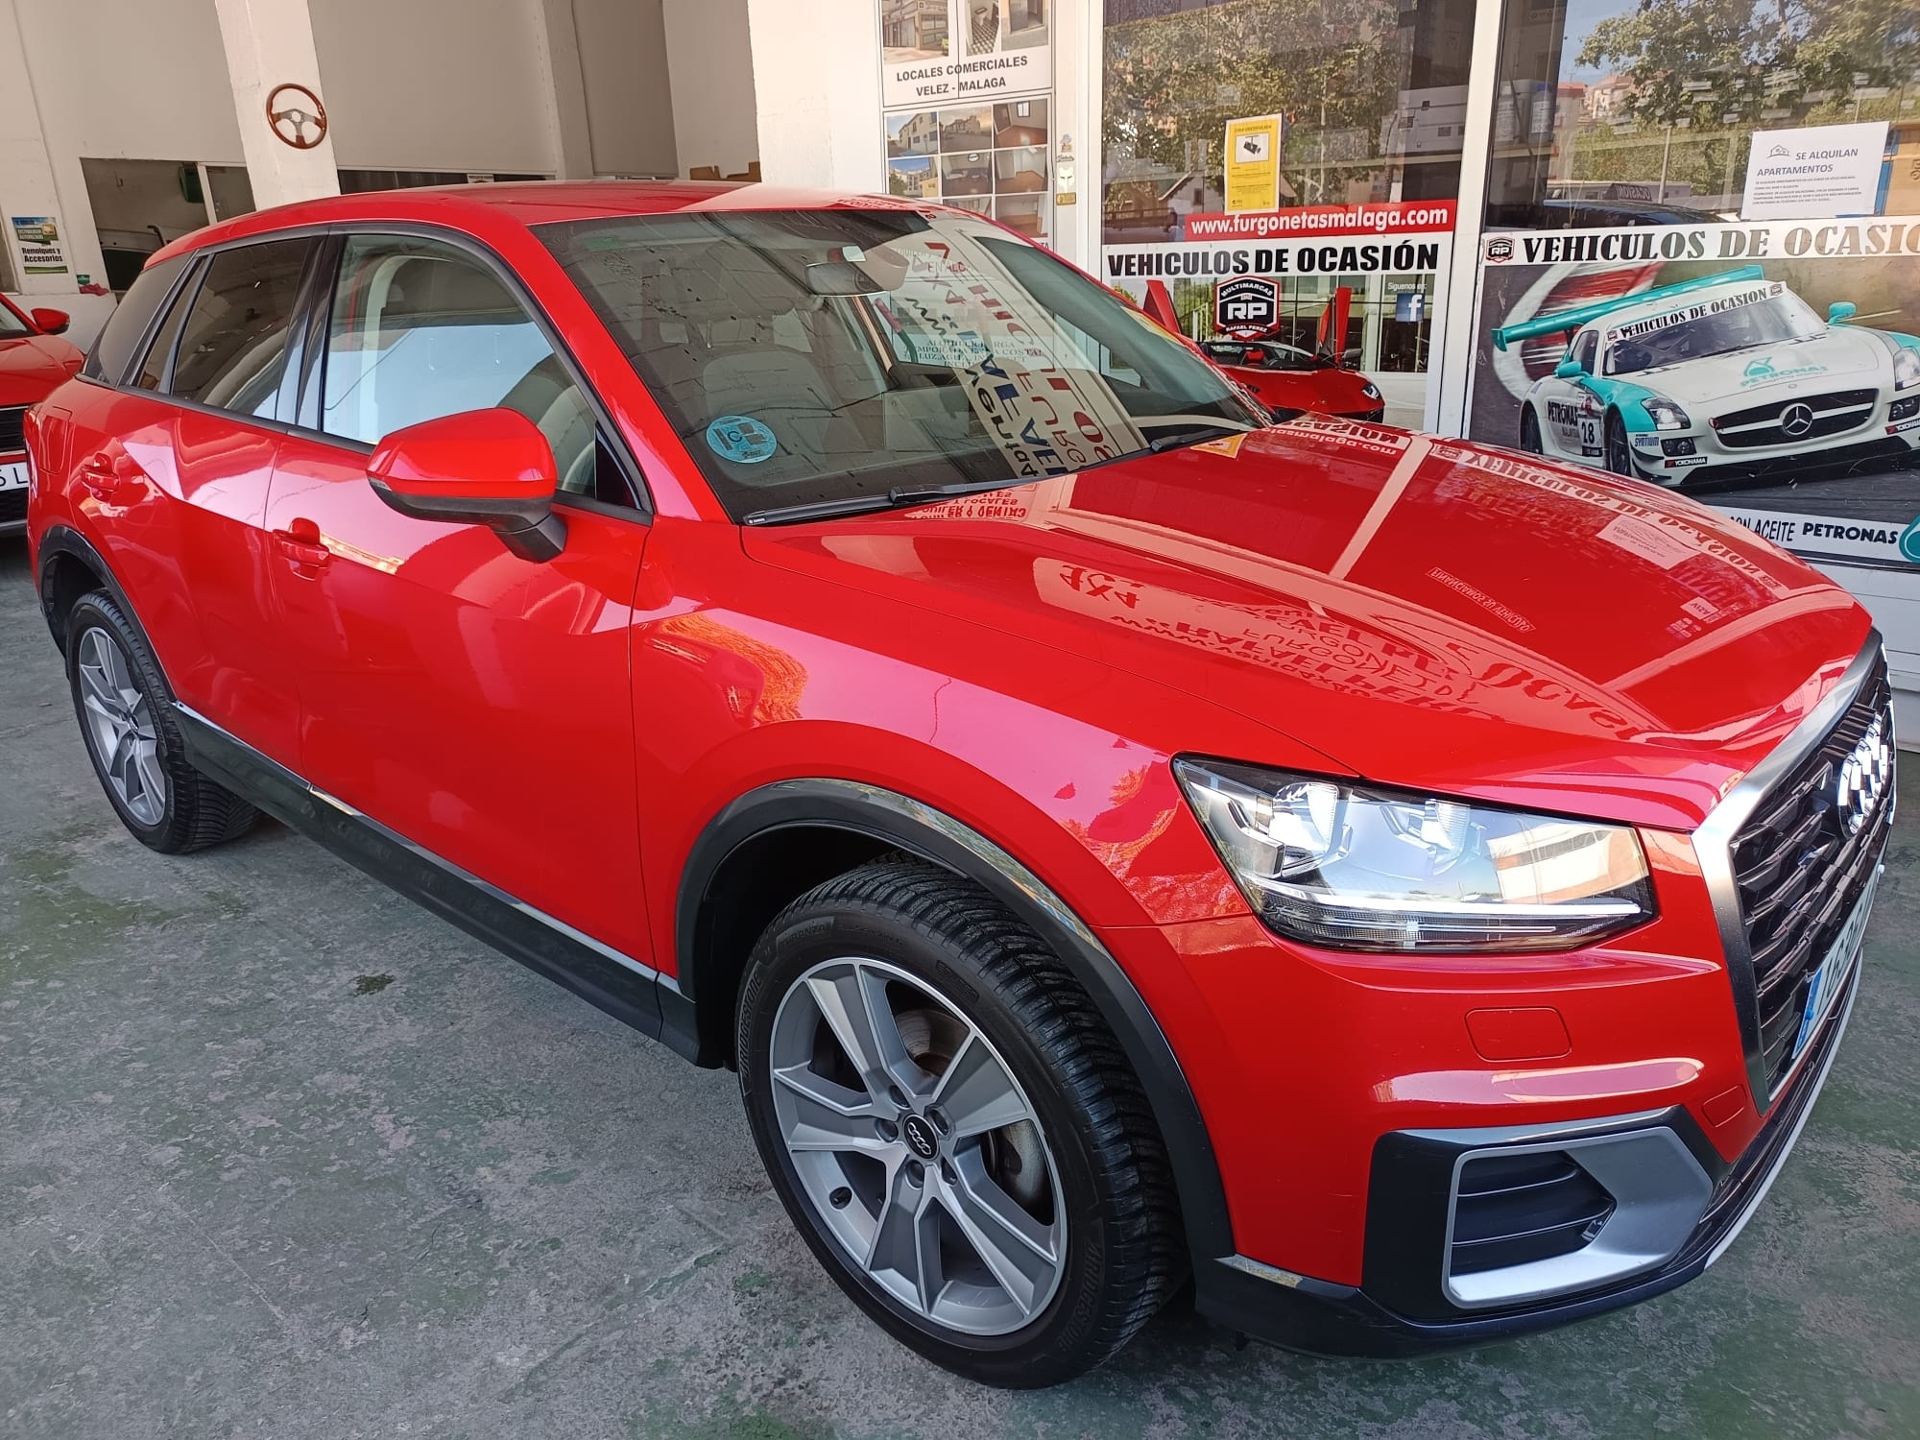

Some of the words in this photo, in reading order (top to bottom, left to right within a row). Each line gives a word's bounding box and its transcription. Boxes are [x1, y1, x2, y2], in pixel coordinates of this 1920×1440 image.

[896, 66, 943, 82] LOCALES
[946, 55, 1028, 76] COMERCIALES
[915, 83, 949, 97] VELEZ
[959, 76, 1007, 92] MALAGA
[1795, 151, 1807, 161] SE
[1808, 148, 1859, 160] ALQUILAN
[1757, 163, 1834, 177] APARTAMENTOS
[1191, 206, 1448, 236] www.furgonetasmalaga.com
[1522, 229, 1706, 263] VEHICULOS
[1719, 228, 1771, 259] DE
[1107, 249, 1250, 277] VEHICULOS
[1254, 248, 1289, 274] DE
[1297, 240, 1438, 273] OCASIÓN
[1221, 282, 1273, 297] MULTIMARCAS
[1227, 302, 1267, 320] RP
[1620, 311, 1686, 338] VEHICULOS
[1690, 304, 1707, 318] DE
[1710, 288, 1767, 313] OCASION
[1741, 365, 1829, 387] PETRONAS
[1581, 421, 1595, 444] 28
[1674, 457, 1707, 467] YOKOHAMA
[1730, 516, 1751, 532] ON
[1754, 519, 1796, 542] ACEITE
[1802, 522, 1898, 545] PETRONAS
